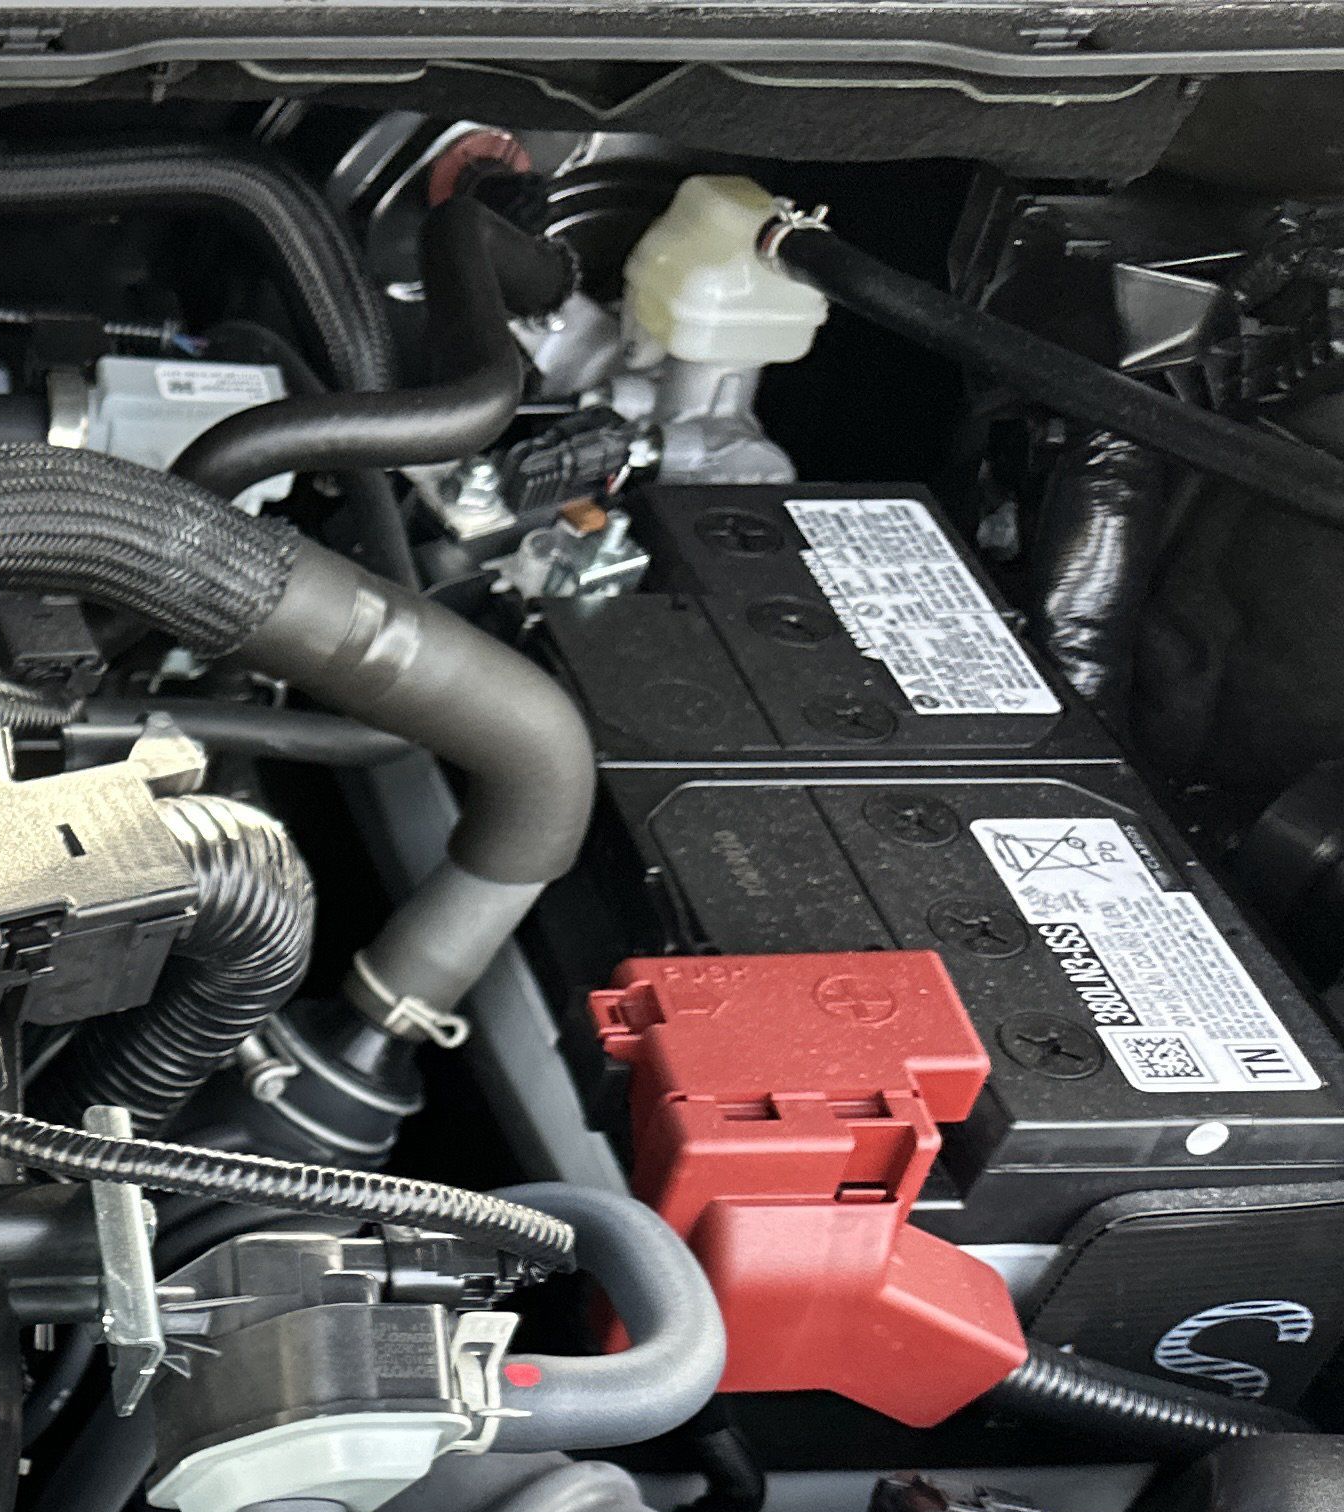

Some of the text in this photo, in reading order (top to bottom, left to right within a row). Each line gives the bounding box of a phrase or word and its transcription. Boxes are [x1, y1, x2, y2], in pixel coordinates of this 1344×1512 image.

[1098, 841, 1125, 863] Pb
[1038, 924, 1137, 1026] 380LN3-ISS
[1234, 1047, 1293, 1079] TN
